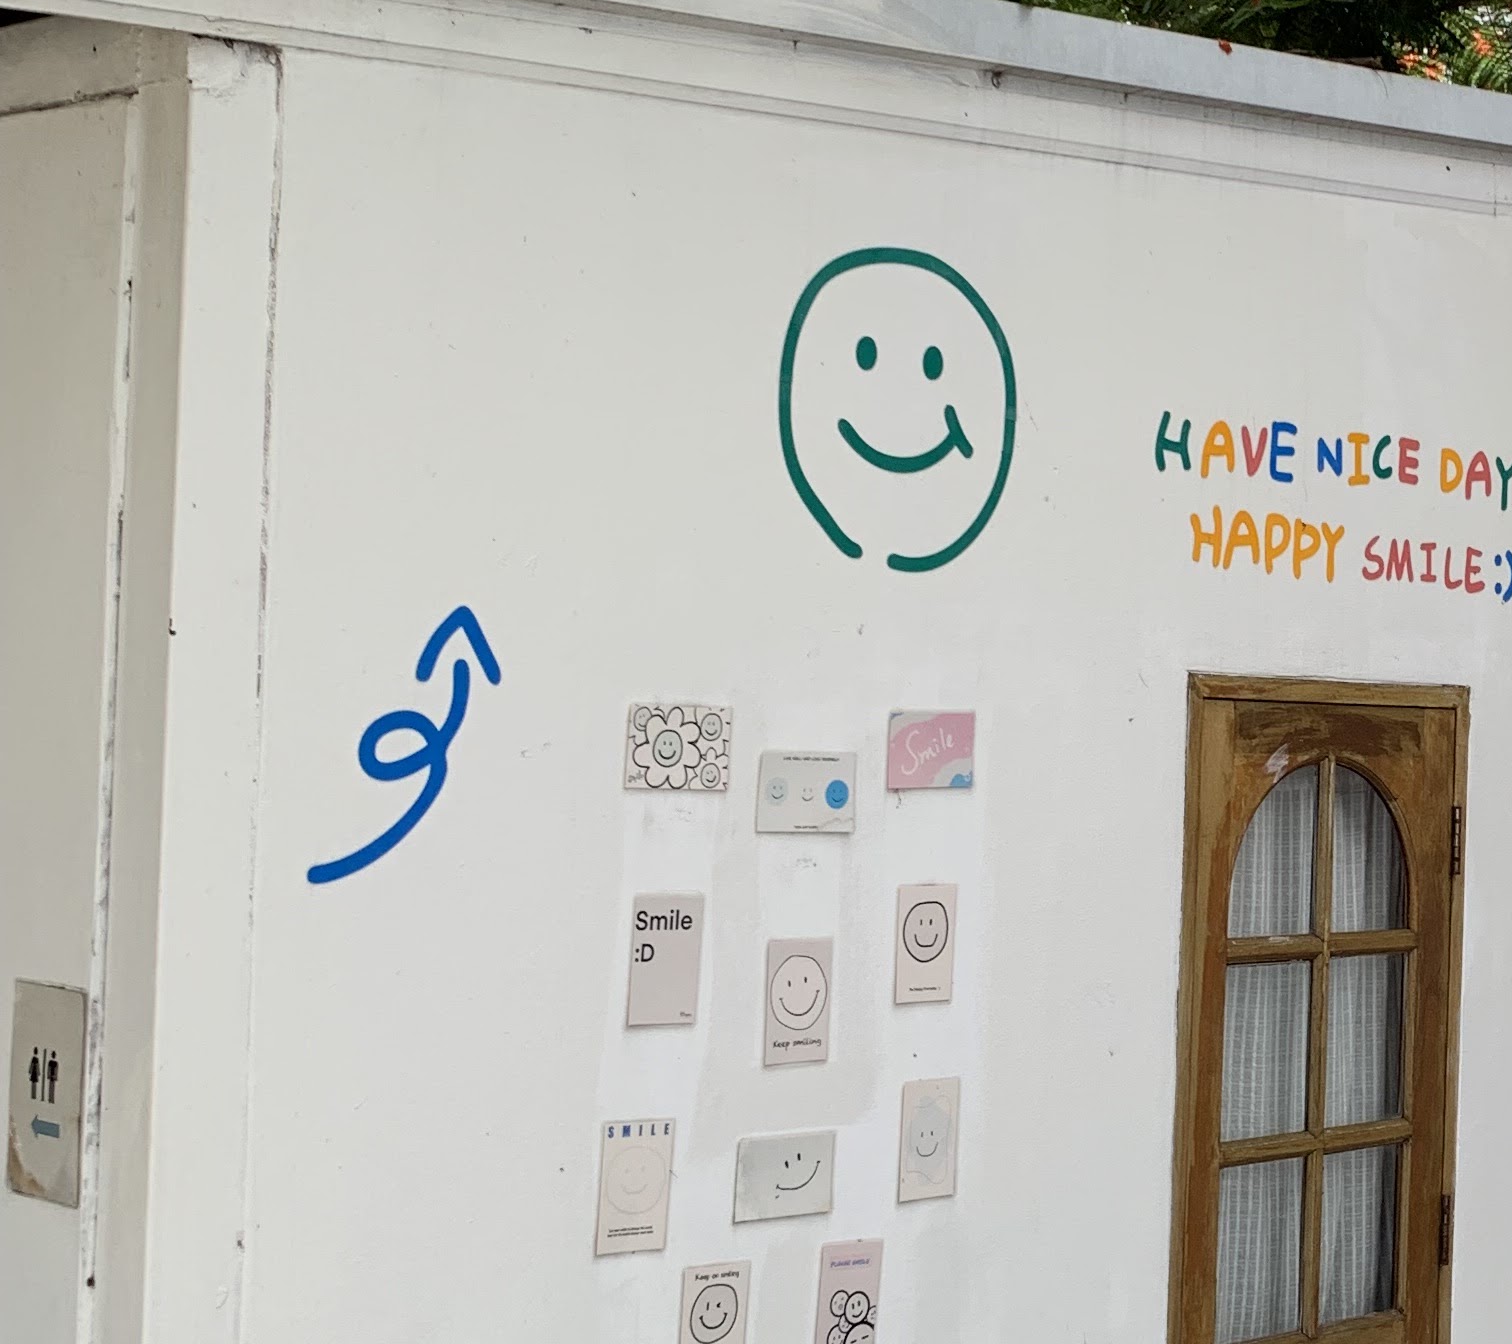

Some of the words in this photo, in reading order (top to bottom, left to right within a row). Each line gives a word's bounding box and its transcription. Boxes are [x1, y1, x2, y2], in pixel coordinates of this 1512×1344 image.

[1154, 410, 1298, 484] HAVE
[1316, 431, 1421, 487] NICE
[1190, 504, 1346, 584] HAPPY
[900, 727, 955, 776] Smile
[635, 908, 693, 931] Smile
[634, 943, 655, 963] :D
